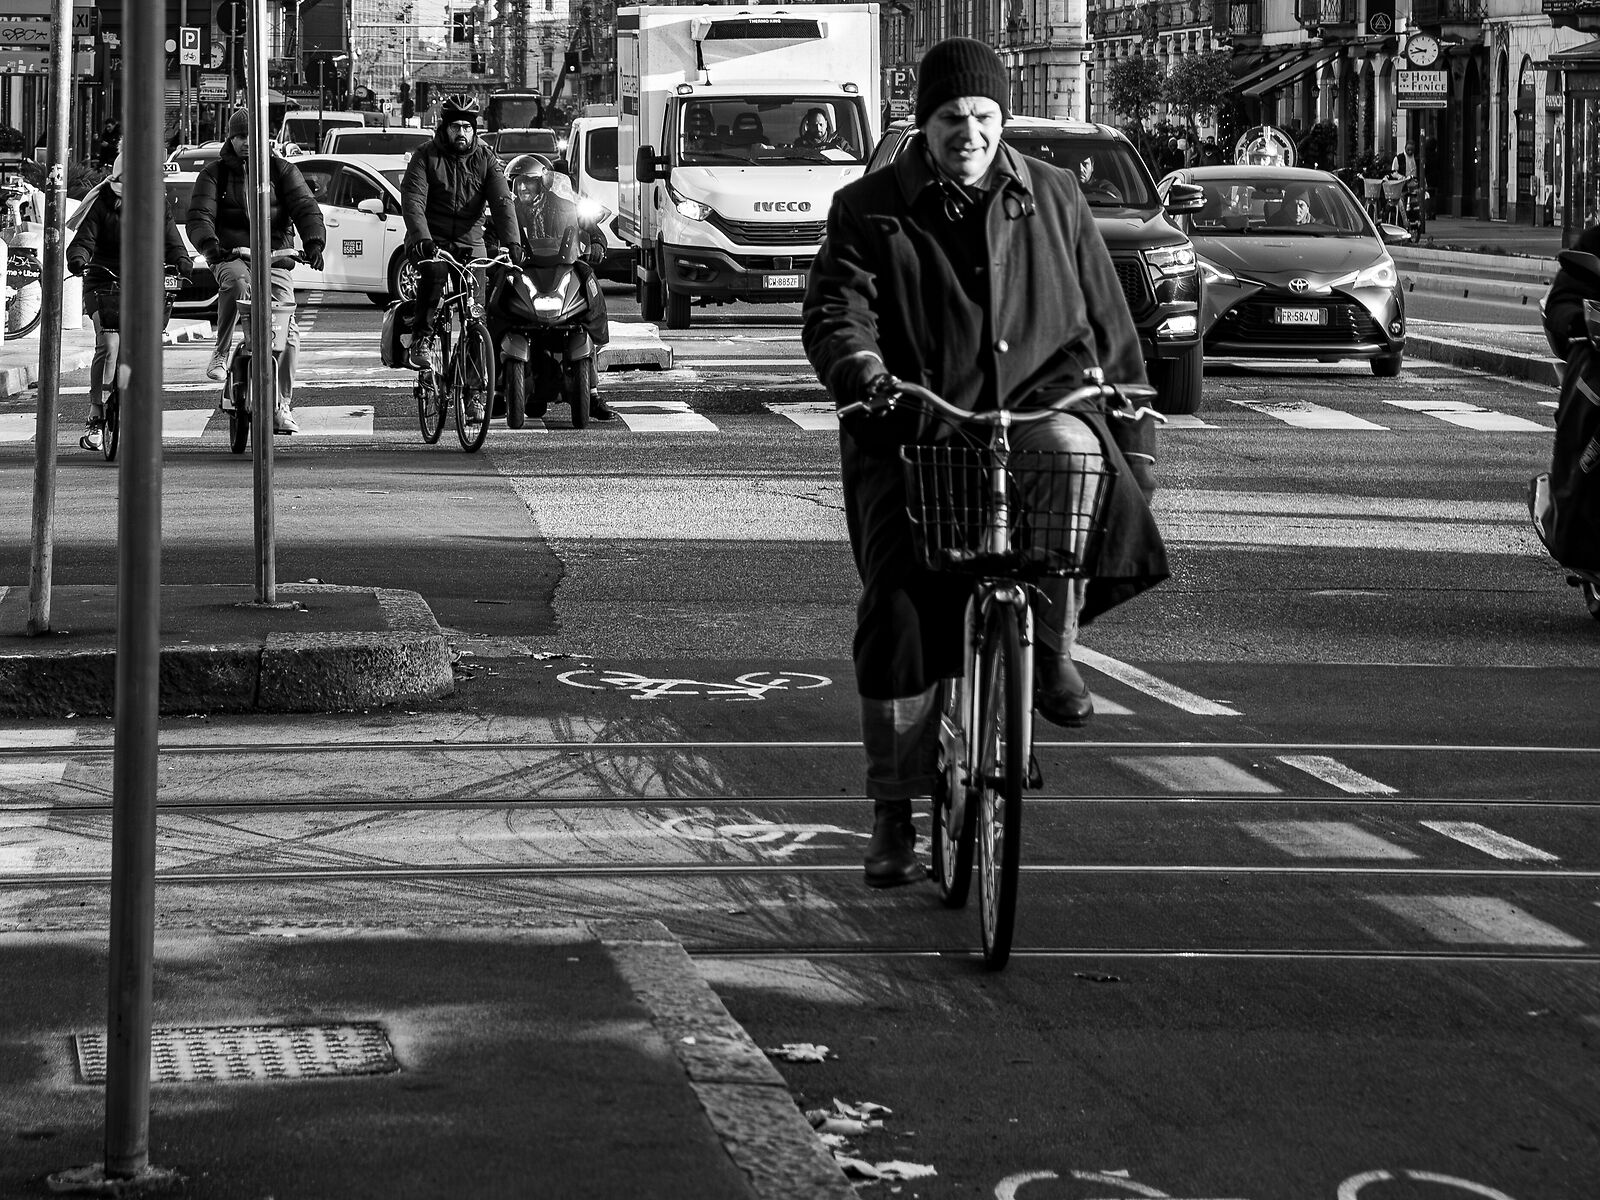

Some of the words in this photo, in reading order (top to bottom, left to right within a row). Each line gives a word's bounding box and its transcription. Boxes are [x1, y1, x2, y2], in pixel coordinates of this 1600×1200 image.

[185, 32, 196, 47] P
[895, 72, 906, 86] P
[1411, 72, 1442, 81] HOTEL
[753, 201, 812, 213] IVECO
